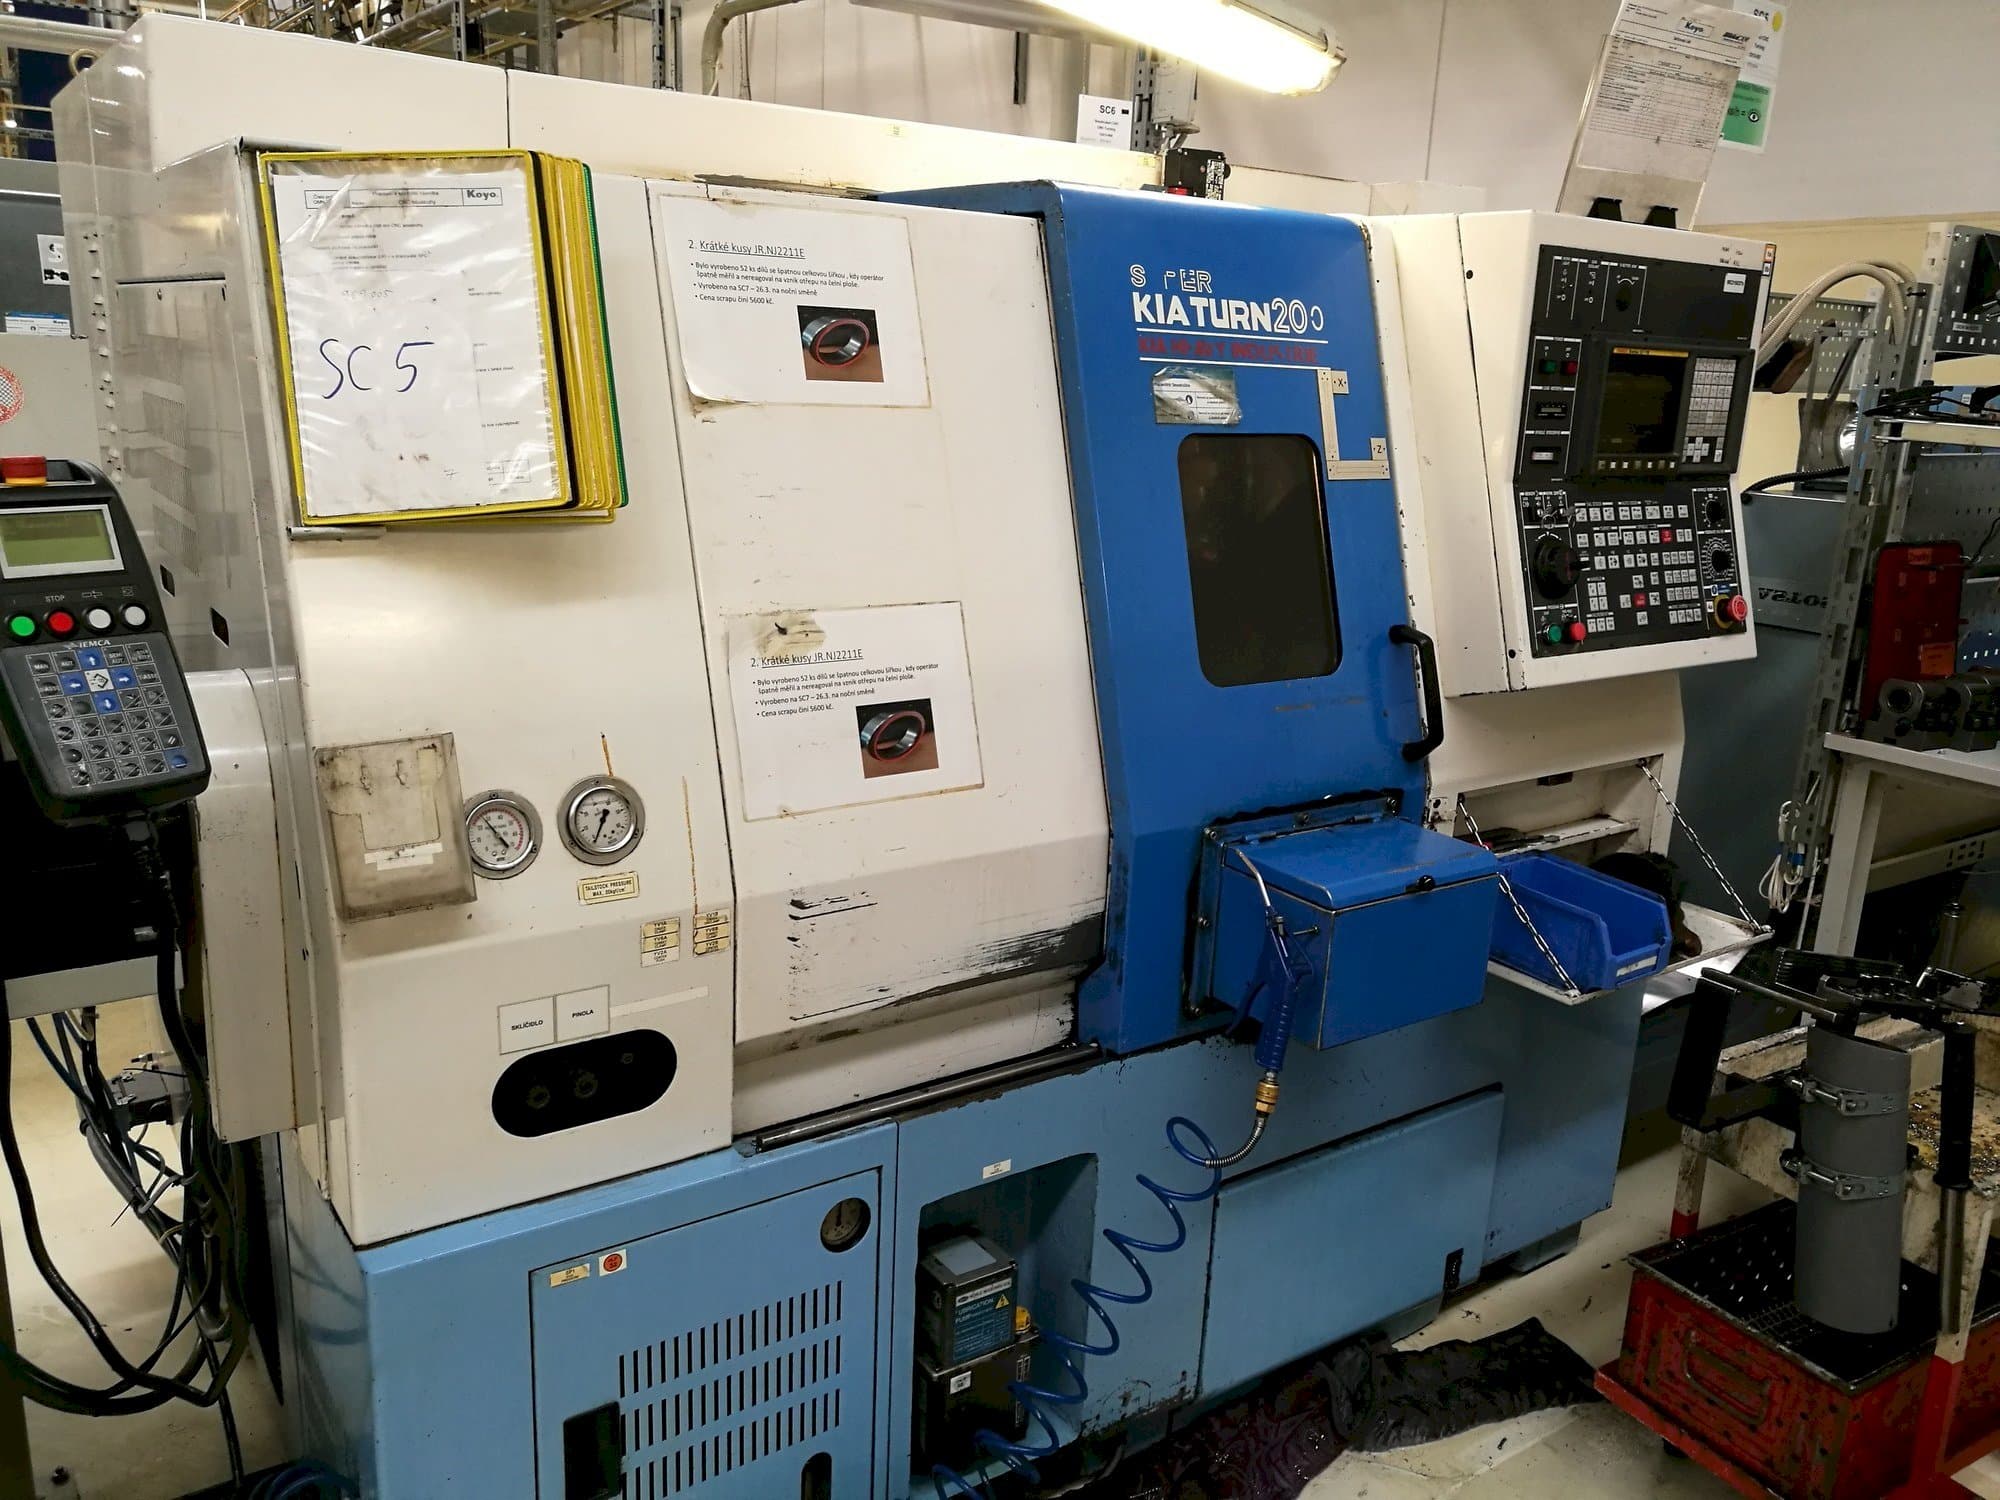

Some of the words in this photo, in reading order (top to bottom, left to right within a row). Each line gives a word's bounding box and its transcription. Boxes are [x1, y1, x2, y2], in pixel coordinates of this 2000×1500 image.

[467, 189, 497, 201] Koyo
[688, 239, 698, 249] 2.
[700, 240, 730, 252] Krátké
[731, 242, 752, 255] kusy
[711, 263, 739, 272] vyrobeno
[698, 282, 728, 291] Vyrobeno
[699, 293, 715, 301] Cena
[716, 294, 736, 303] scrapu
[395, 341, 436, 393] 5
[1337, 377, 1345, 387] X
[1376, 444, 1383, 454] Z
[45, 594, 65, 603] STOP
[79, 640, 111, 648] IEMCA
[751, 657, 760, 668] 2.
[761, 654, 790, 666] Krátké
[792, 653, 812, 665] kusy
[757, 678, 771, 687] Bylo
[772, 677, 800, 686] vyrobeno
[800, 674, 808, 682] 52
[760, 696, 790, 706] Vyrobeno
[761, 709, 777, 717] Cena
[778, 707, 798, 716] scrapu
[572, 1009, 594, 1018] PINOLA
